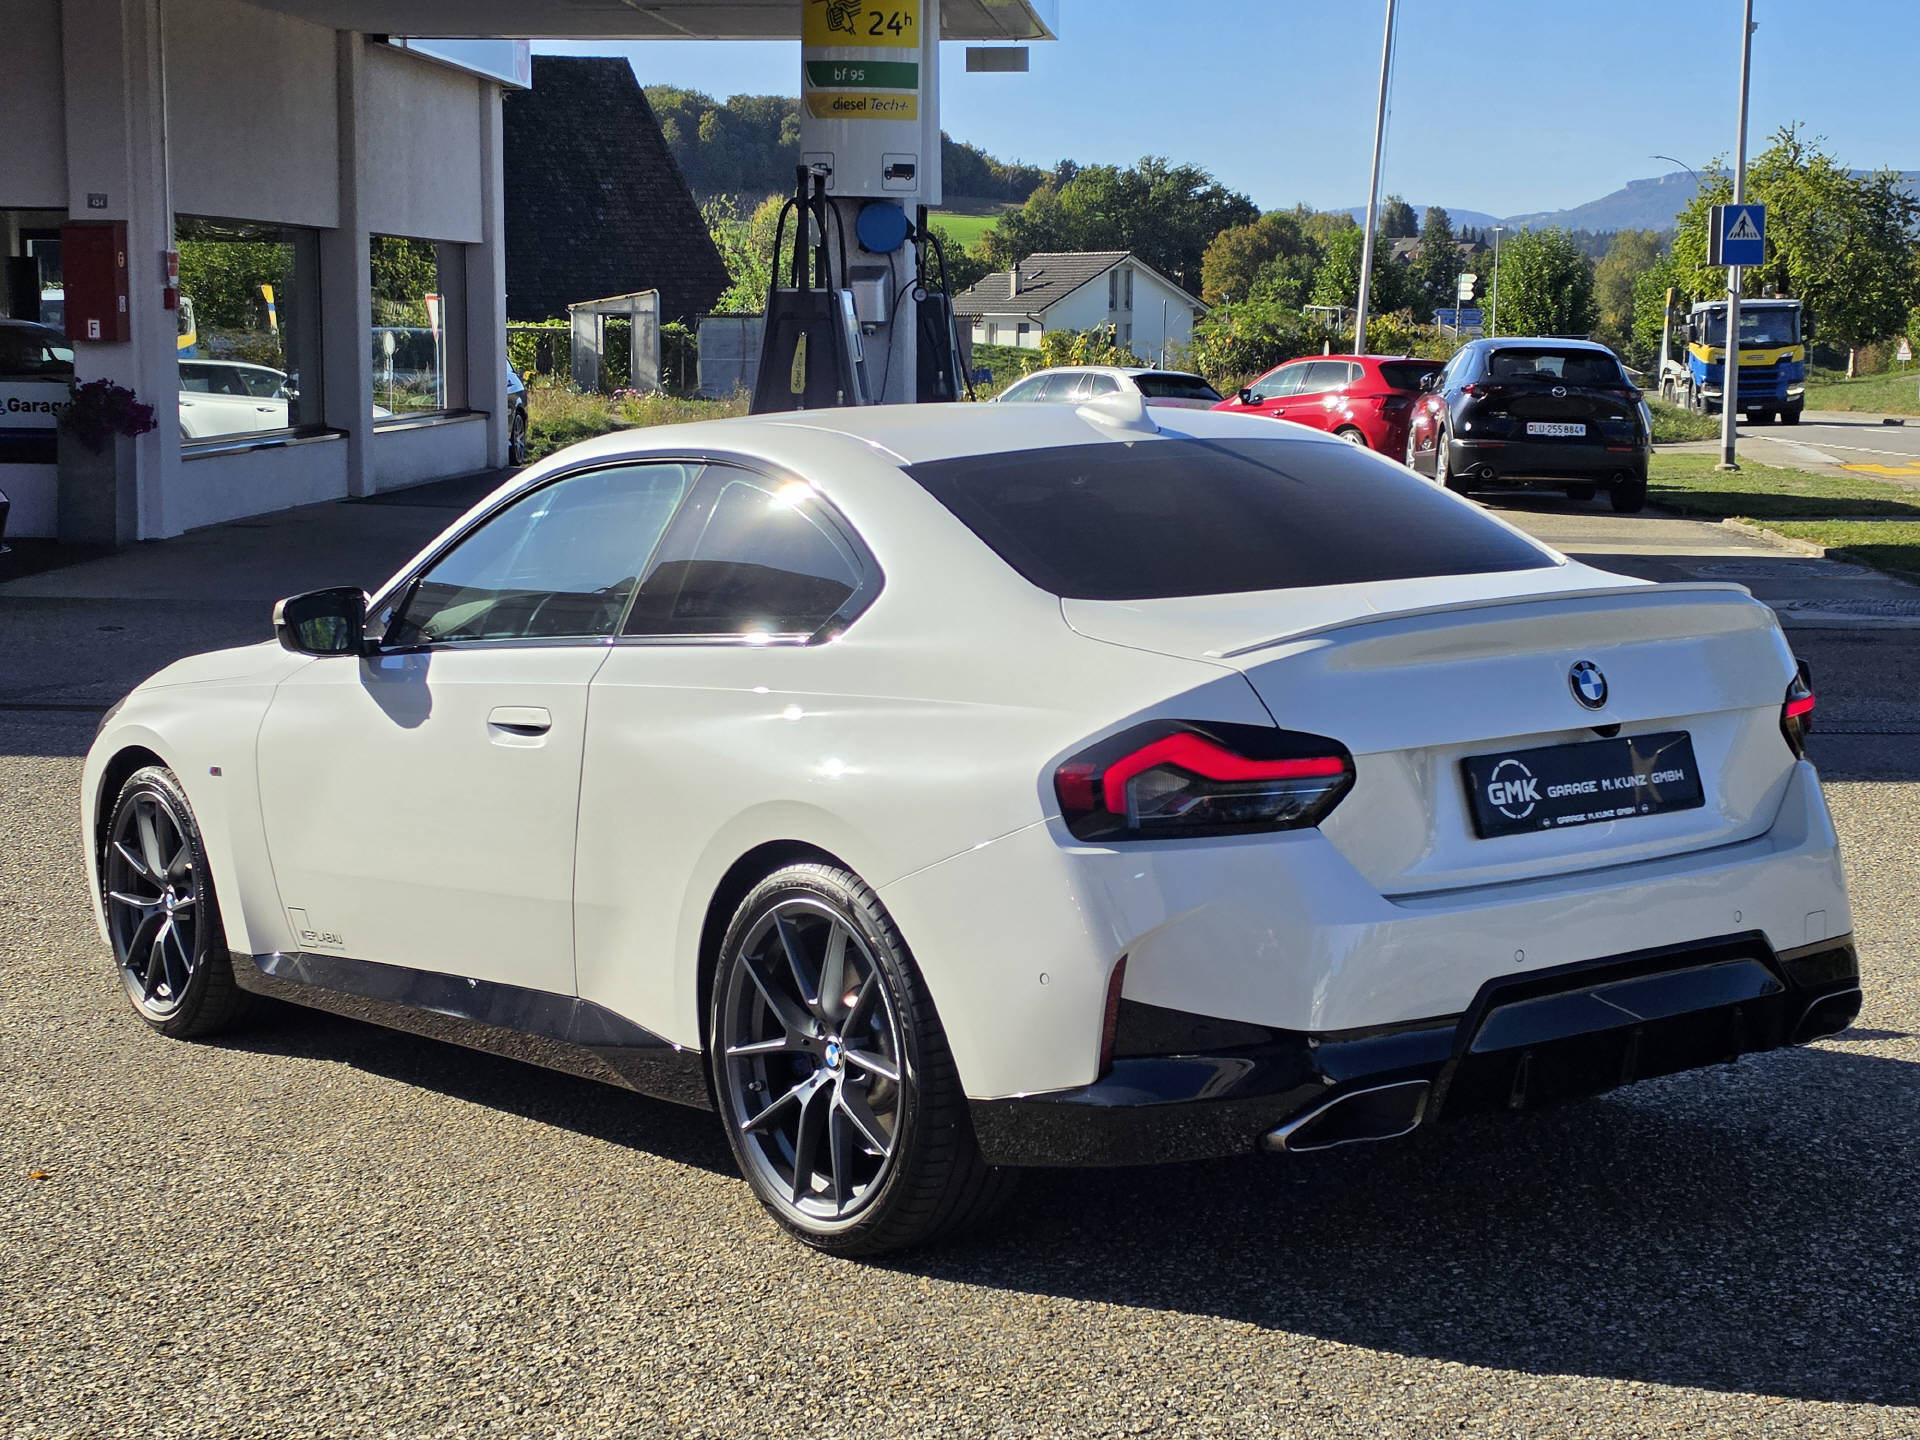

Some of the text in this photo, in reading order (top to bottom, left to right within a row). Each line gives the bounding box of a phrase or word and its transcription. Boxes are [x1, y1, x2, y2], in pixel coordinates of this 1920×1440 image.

[834, 69, 865, 81] bf 95
[833, 97, 909, 111] diesel Tech+
[90, 322, 97, 336] F
[1547, 769, 1684, 798] GARAGE M.KUNZ GMBH
[1487, 777, 1543, 806] GMK
